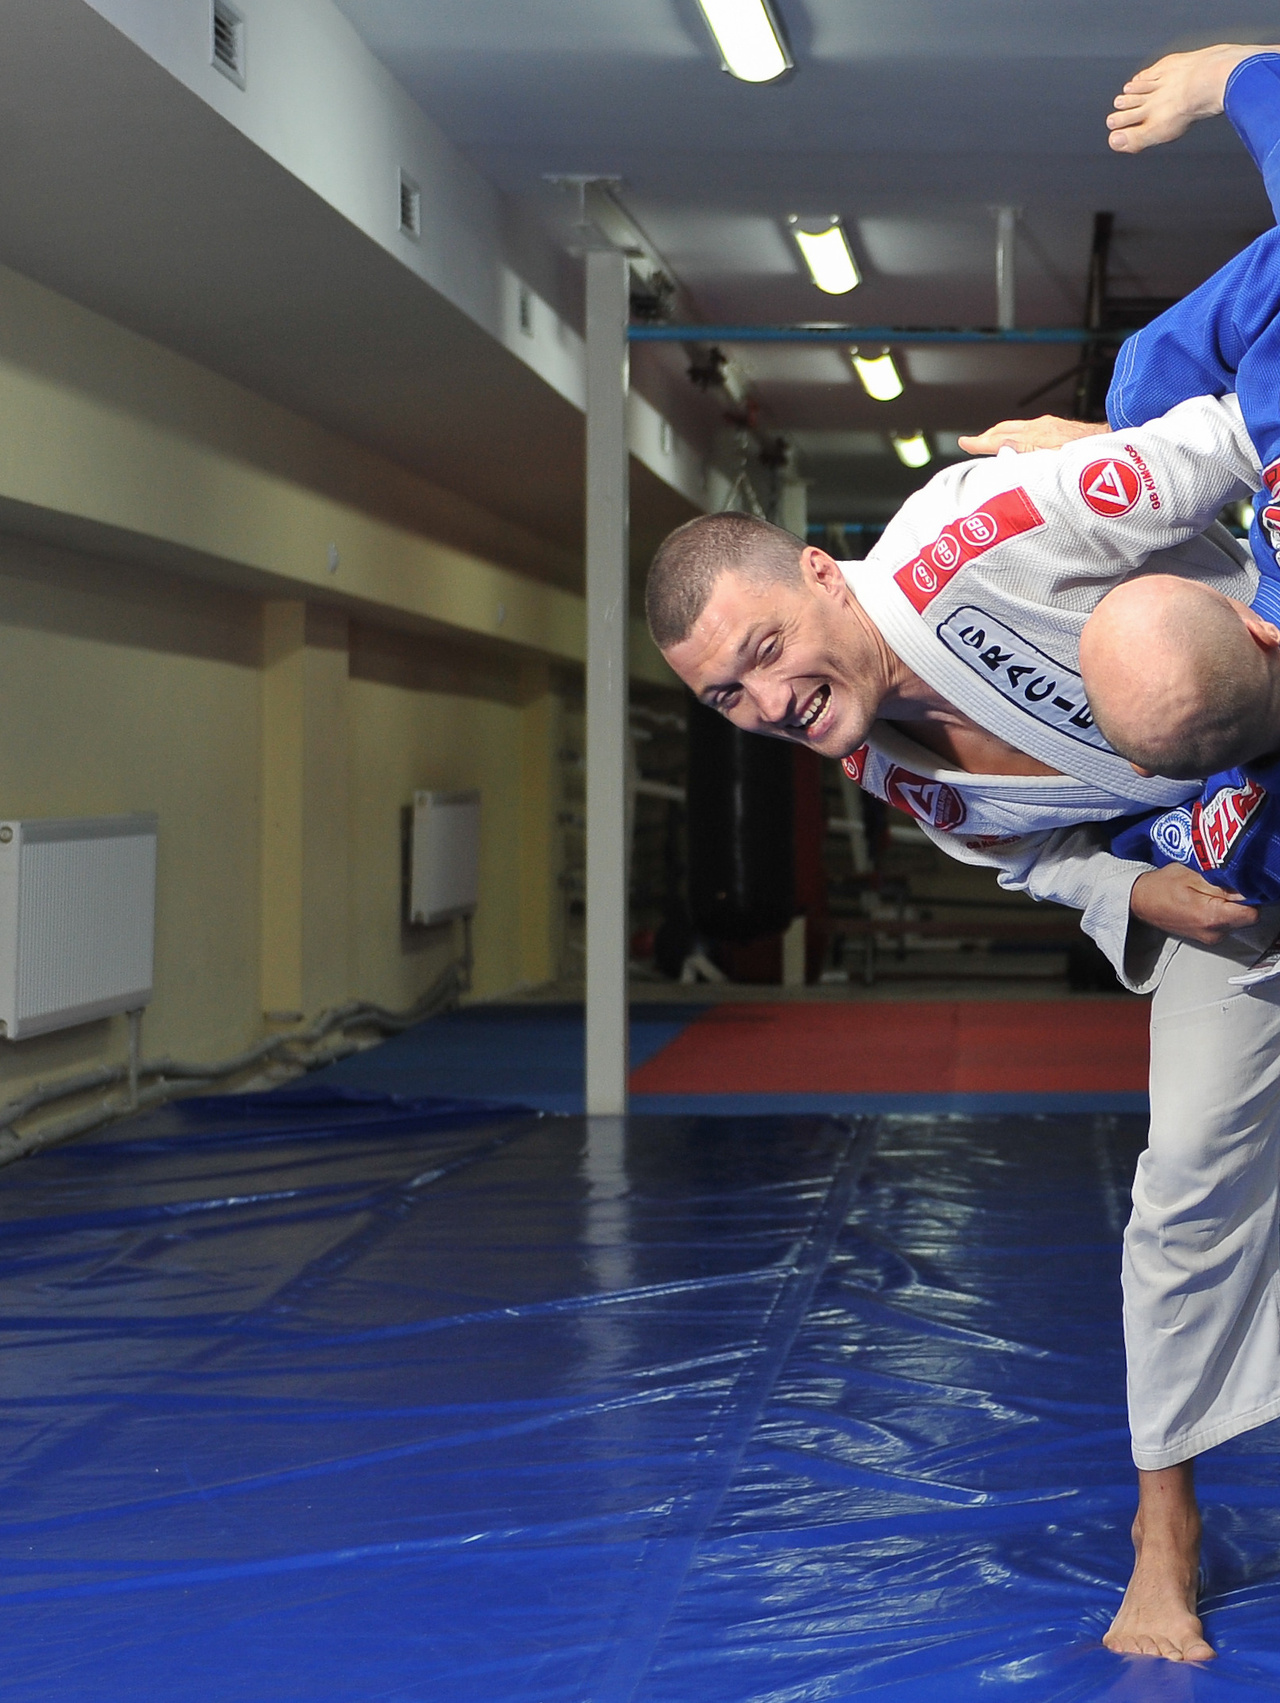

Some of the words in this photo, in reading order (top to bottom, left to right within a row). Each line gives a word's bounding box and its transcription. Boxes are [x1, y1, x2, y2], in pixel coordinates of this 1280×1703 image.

[1124, 444, 1156, 491] KIMONOS
[1149, 492, 1161, 510] GB
[965, 517, 990, 540] GB
[937, 540, 954, 564] GB
[958, 625, 1094, 729] GRACIE
